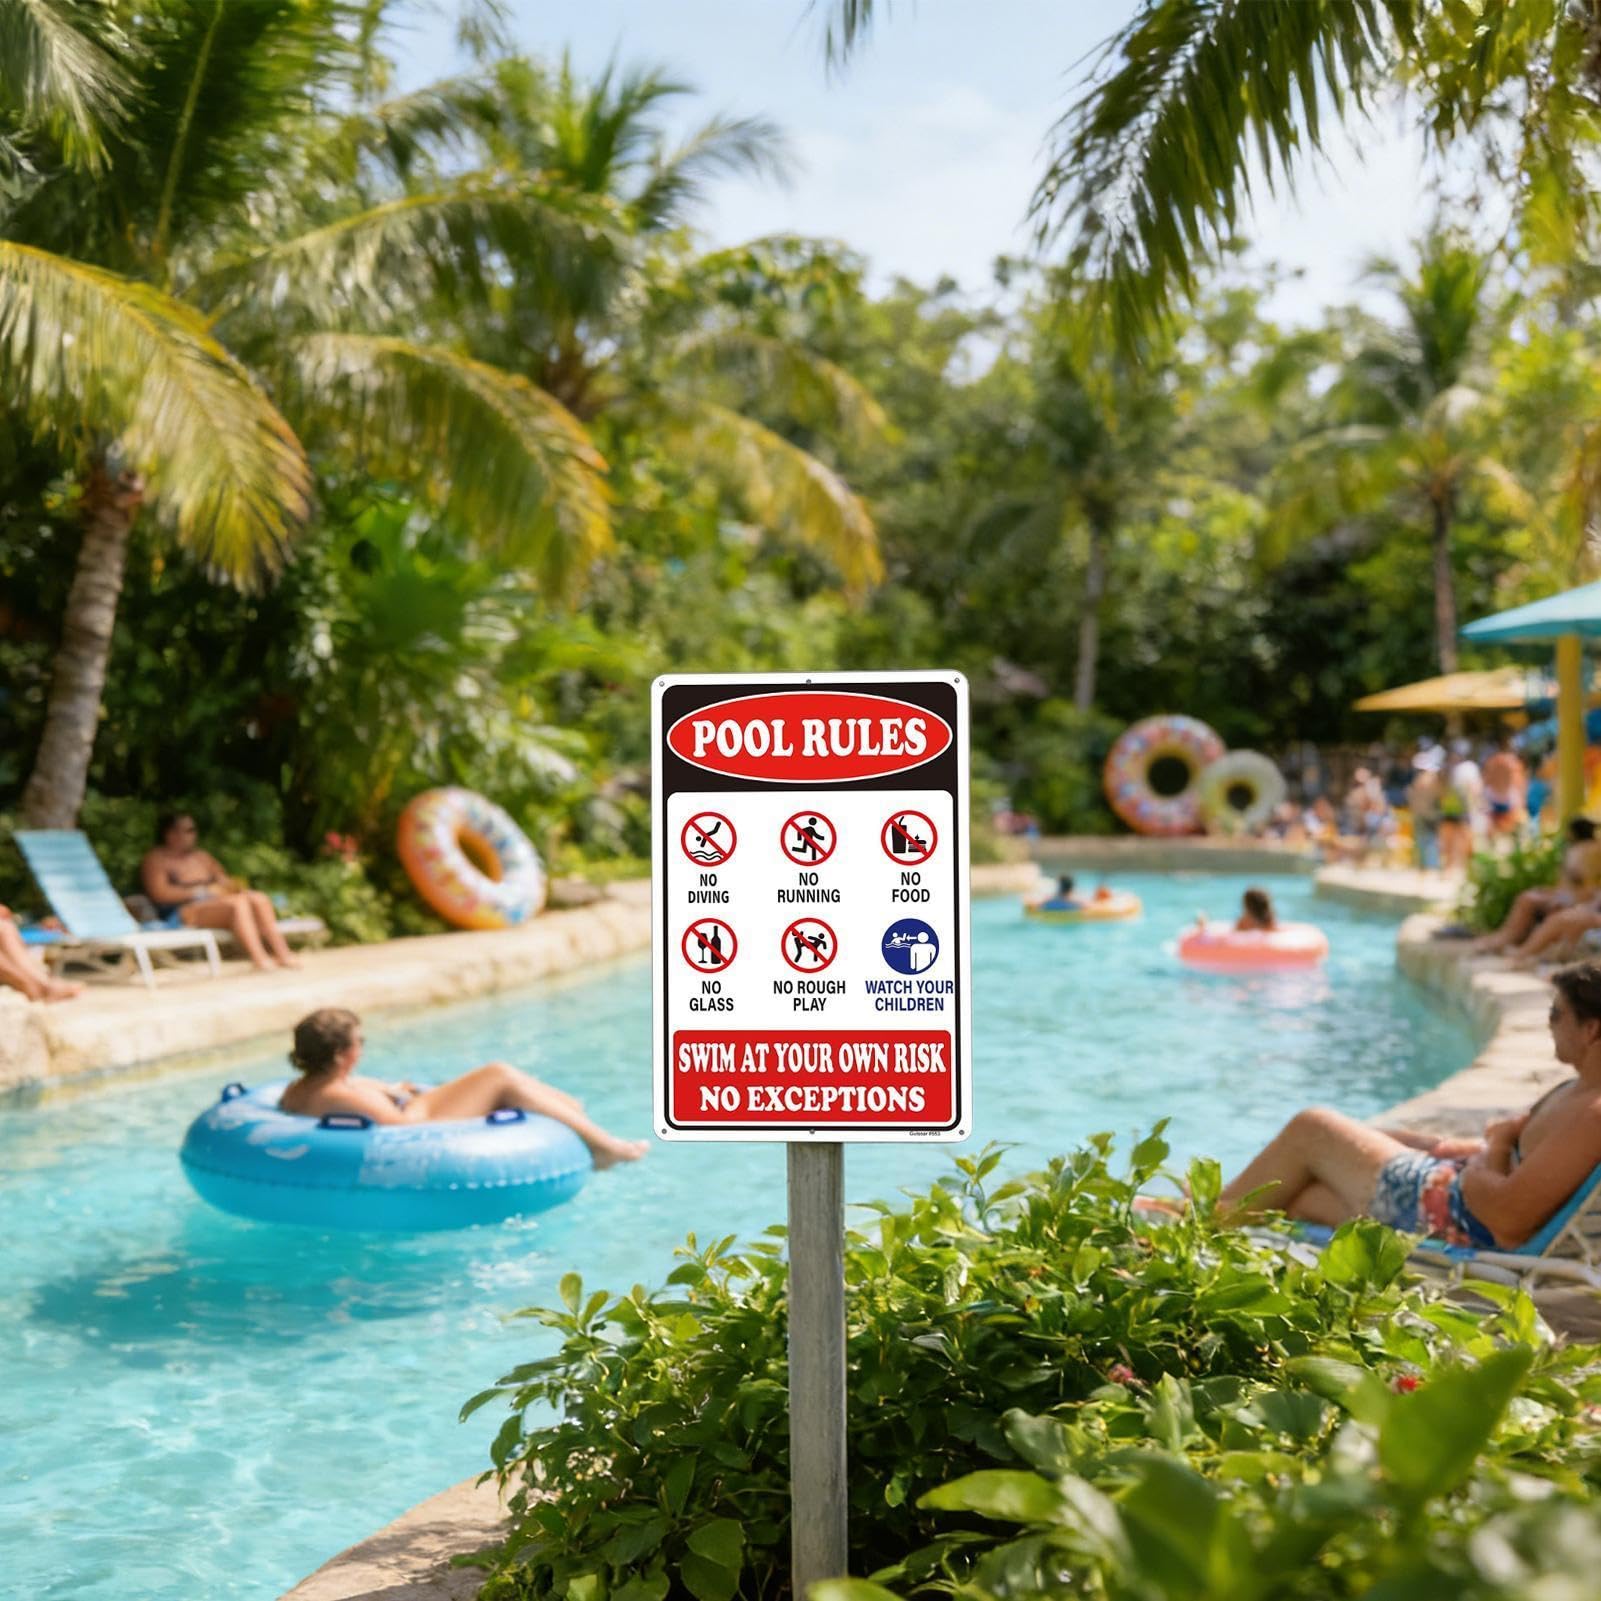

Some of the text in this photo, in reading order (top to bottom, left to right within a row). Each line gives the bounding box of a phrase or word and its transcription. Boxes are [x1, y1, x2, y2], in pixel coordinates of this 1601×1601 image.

[692, 718, 927, 757] POOL RULES
[700, 873, 718, 887] NO
[799, 872, 819, 886] NO
[901, 872, 921, 886] NO
[688, 890, 730, 904] DIVING
[777, 889, 841, 903] RUNNING
[892, 889, 930, 903] FOOD
[702, 980, 722, 994] NO
[774, 980, 846, 994] NO ROUGH
[865, 980, 954, 994] WATCH YOUR
[689, 997, 734, 1012] GLASS
[793, 997, 827, 1012] PLAY
[875, 997, 944, 1012] CHILDREN
[679, 1043, 947, 1073] SWIM AT YOUR OWN RISK
[700, 1086, 926, 1112] NO EXCEPTIONS
